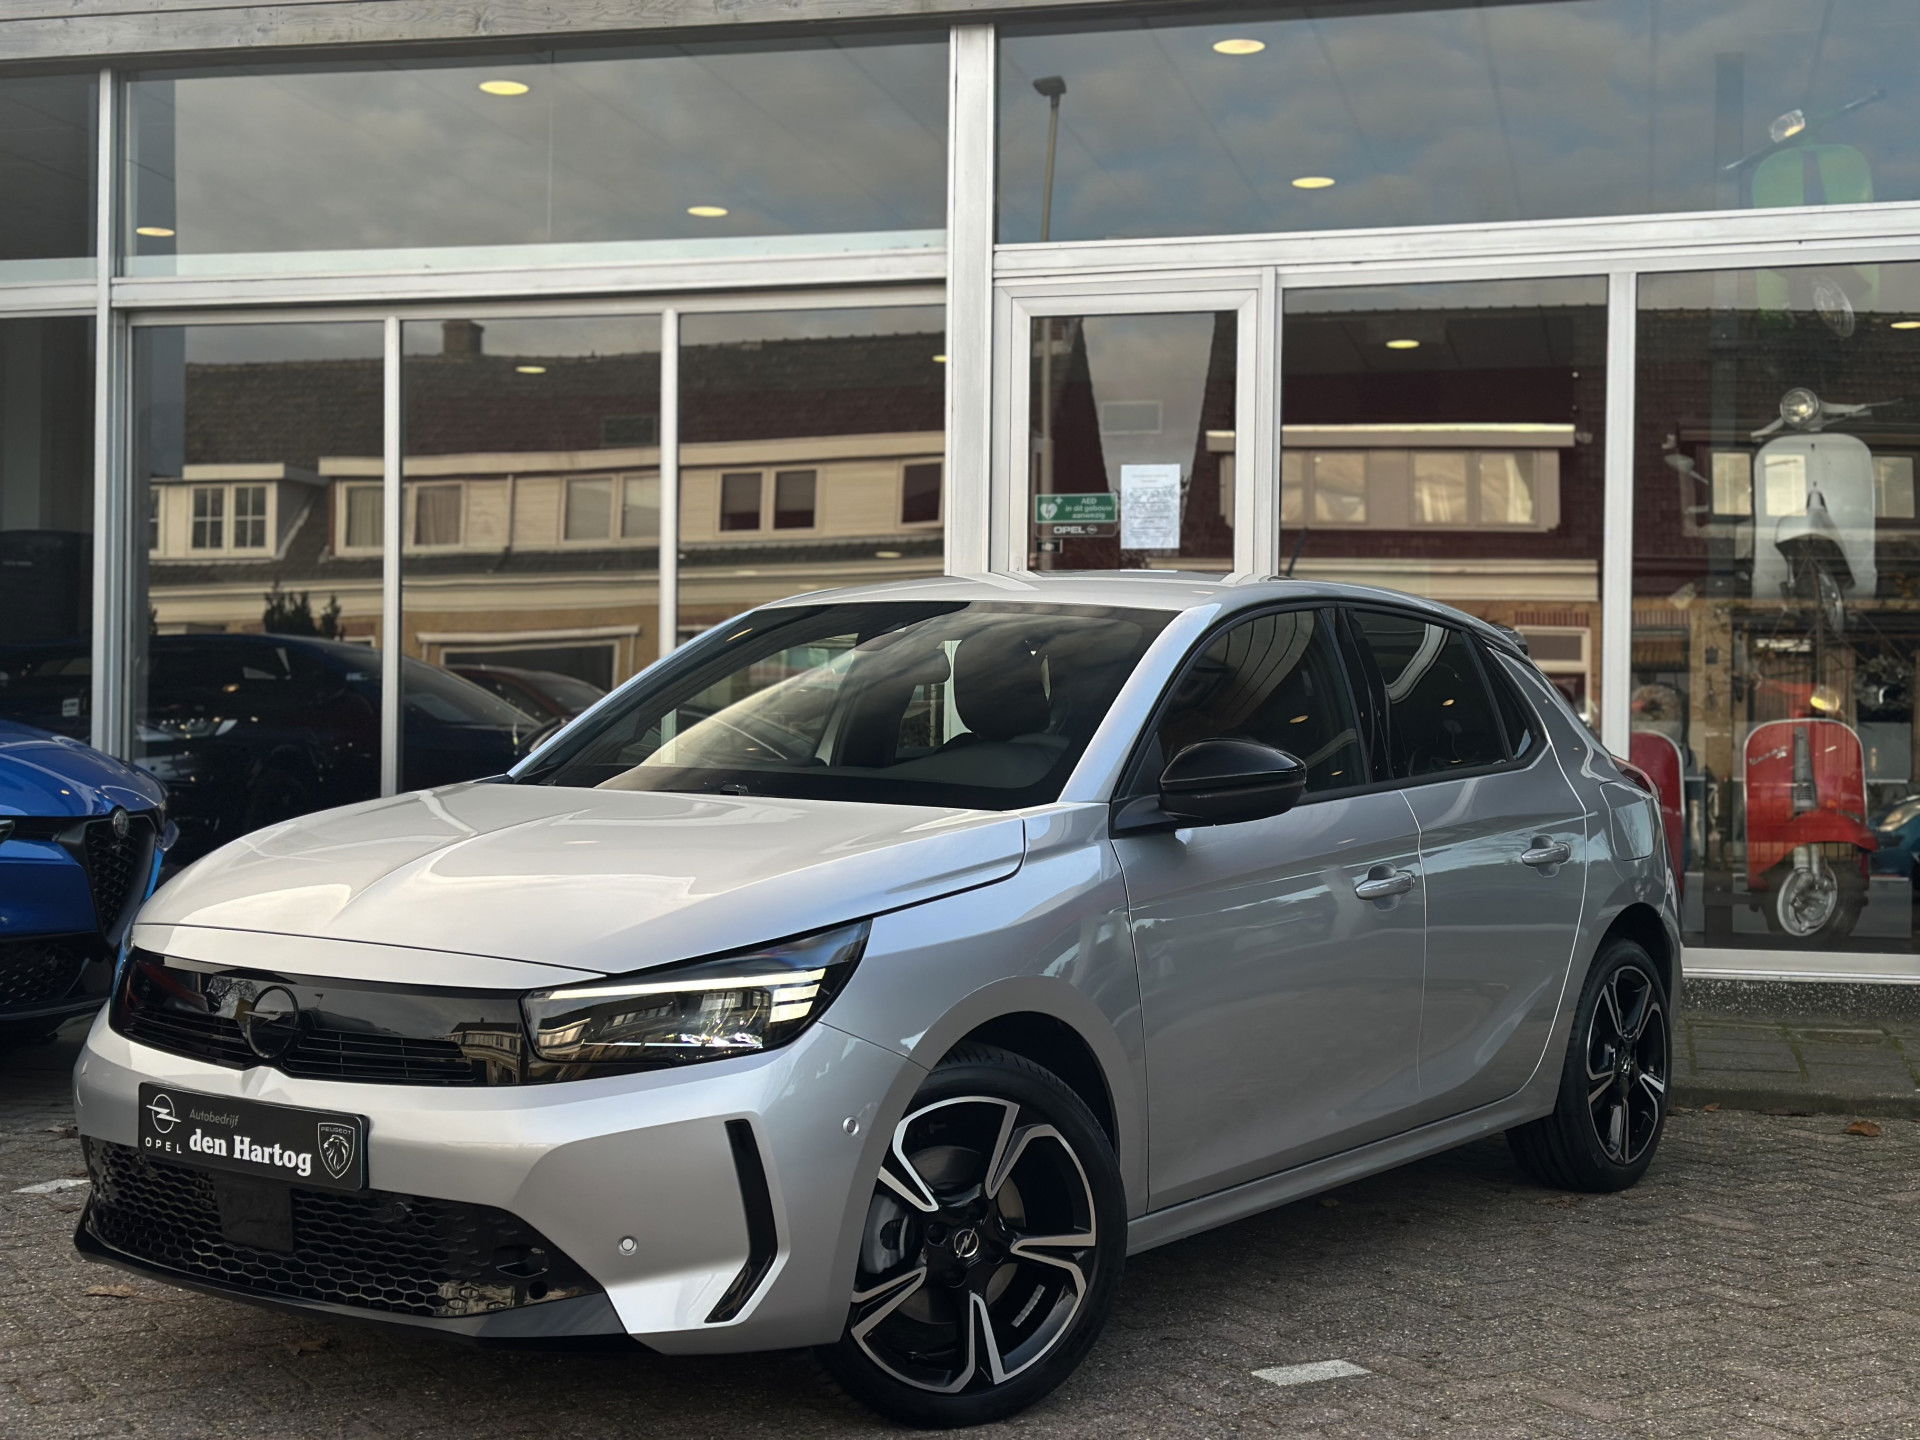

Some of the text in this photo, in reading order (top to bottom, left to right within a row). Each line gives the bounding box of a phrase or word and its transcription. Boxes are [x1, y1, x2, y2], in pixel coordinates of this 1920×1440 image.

[1084, 505, 1112, 513] gebouw
[1053, 525, 1086, 534] OPEL
[189, 1108, 239, 1128] Autobedrijf
[320, 1126, 352, 1135] PEUGEOT
[145, 1137, 182, 1154] OPEL
[189, 1128, 312, 1176] den Hartog
